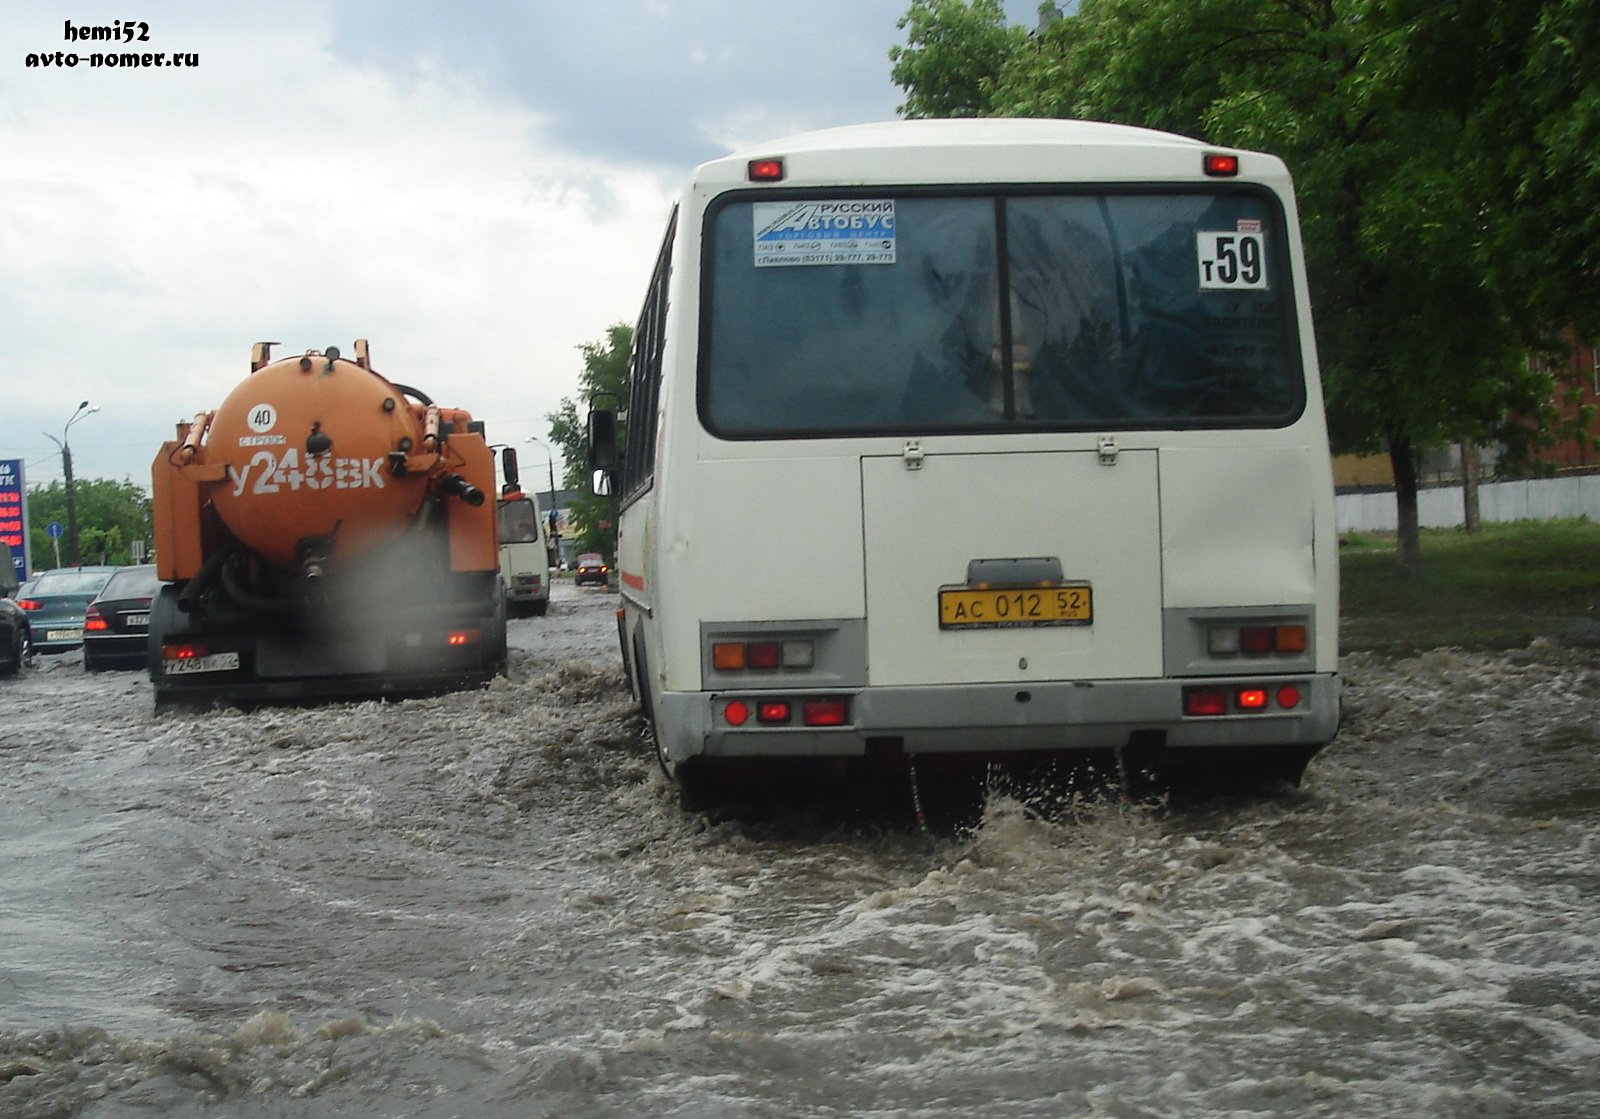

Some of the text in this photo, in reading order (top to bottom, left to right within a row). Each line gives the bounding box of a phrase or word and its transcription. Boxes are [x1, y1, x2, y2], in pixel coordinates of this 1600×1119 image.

[821, 201, 893, 213] РУССКИЙ
[254, 409, 270, 426] 40
[954, 591, 1081, 619] АС 012 52
